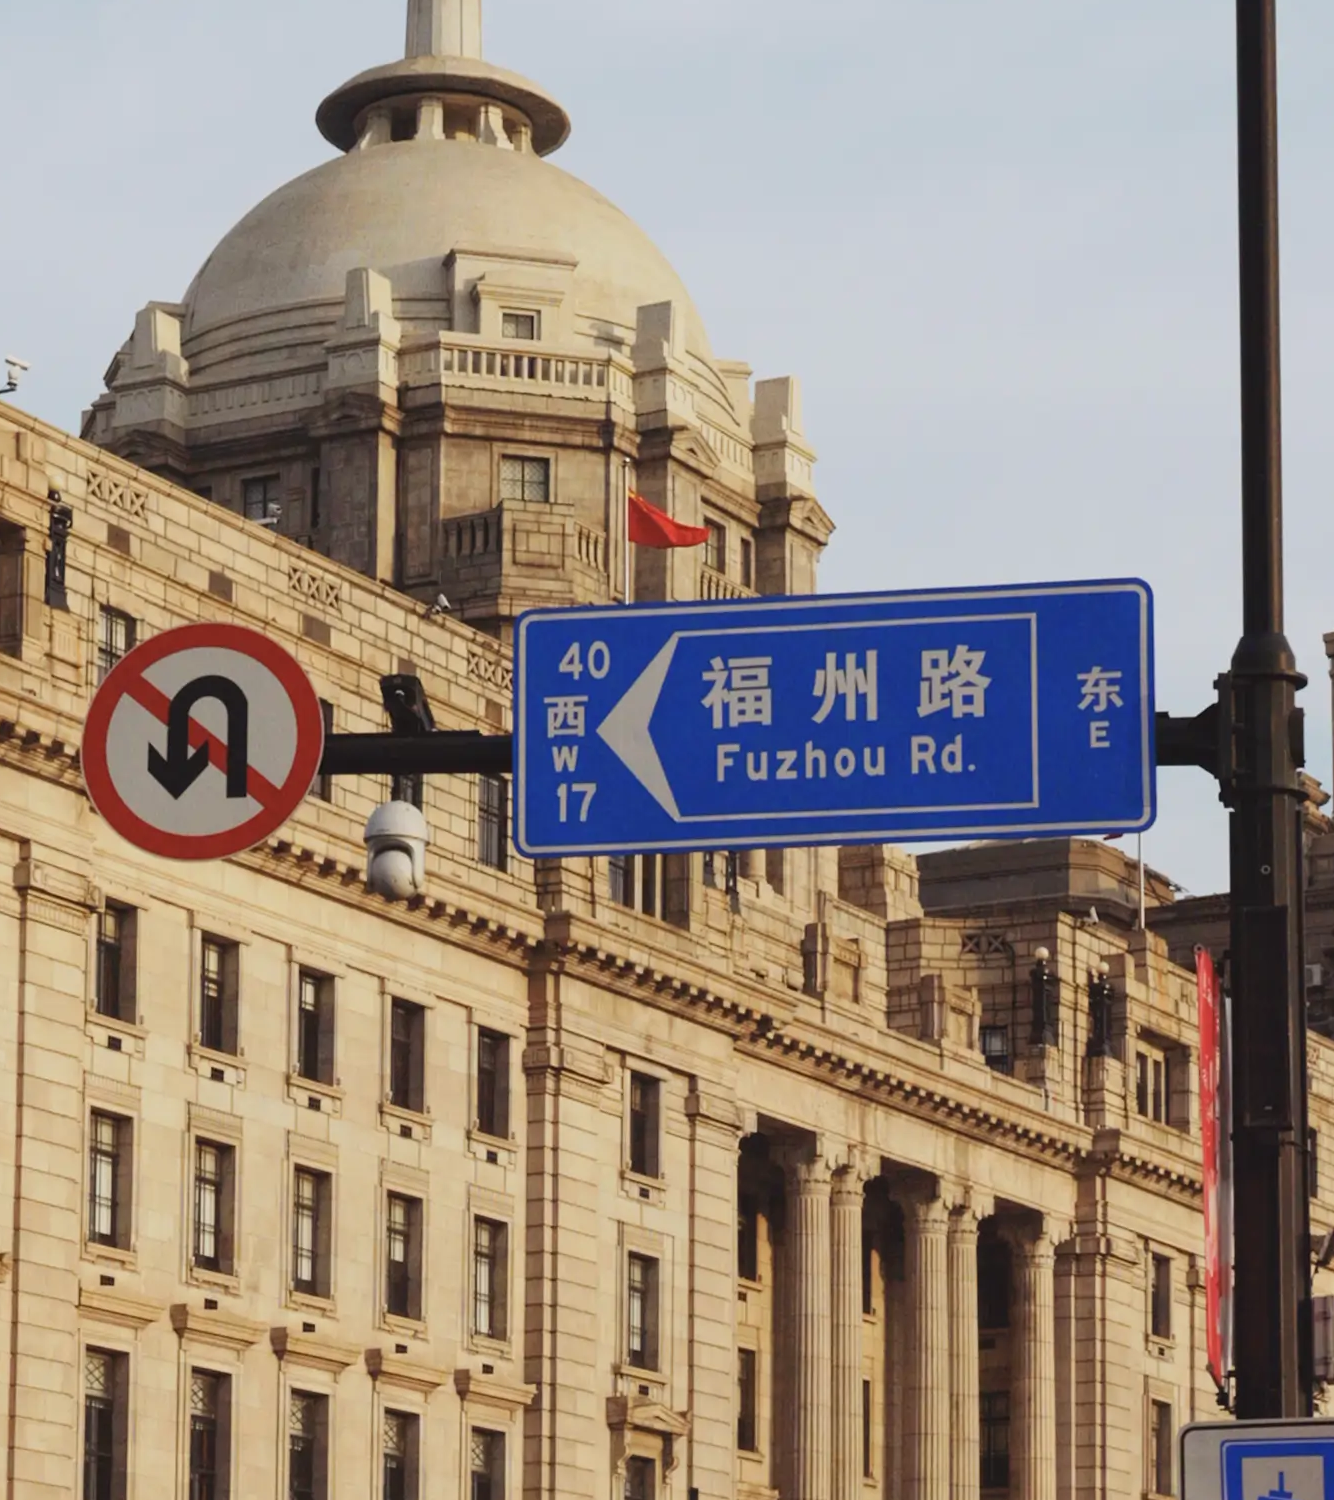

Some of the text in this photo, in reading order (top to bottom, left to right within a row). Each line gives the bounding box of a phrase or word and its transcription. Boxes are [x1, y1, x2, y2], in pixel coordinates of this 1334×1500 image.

[558, 640, 610, 680] 40
[701, 644, 992, 729] 福州路
[1077, 666, 1124, 712] 东
[543, 695, 589, 739] 西
[1090, 720, 1110, 748] E
[552, 745, 579, 773] W
[716, 733, 976, 782] Fuzhou Rd.
[557, 783, 597, 822] 17
